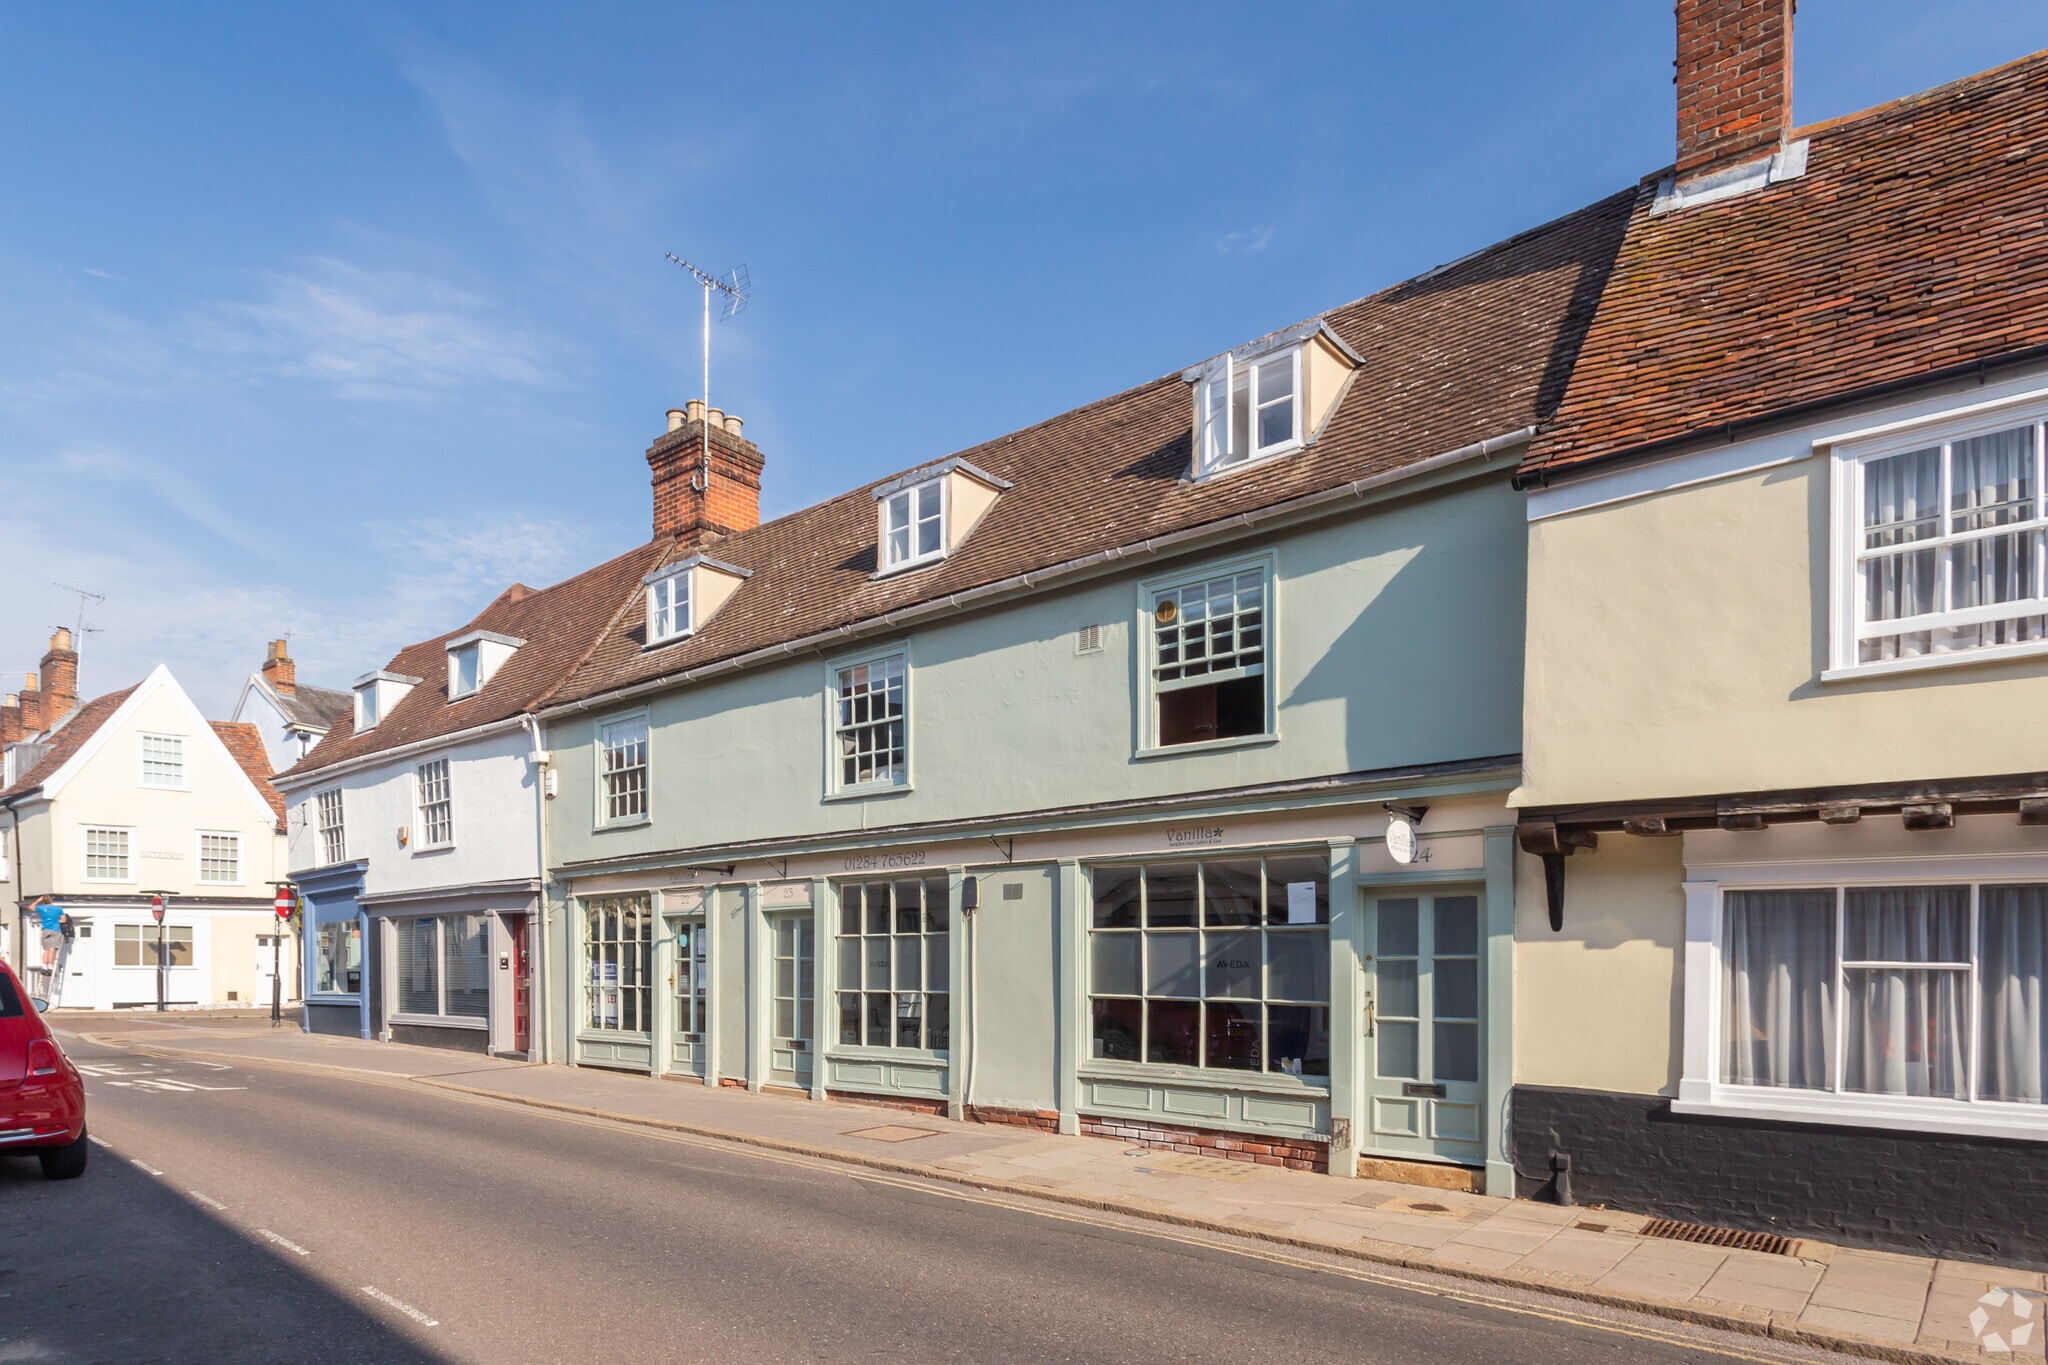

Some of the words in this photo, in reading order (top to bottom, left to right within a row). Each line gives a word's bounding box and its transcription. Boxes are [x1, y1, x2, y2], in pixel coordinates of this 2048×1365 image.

[1166, 826, 1212, 842] Vanilla
[844, 855, 878, 870] 01284
[882, 851, 926, 868] 765622
[869, 960, 890, 968] AVEDA
[1216, 960, 1250, 969] AVEDA
[607, 994, 617, 1004] LET
